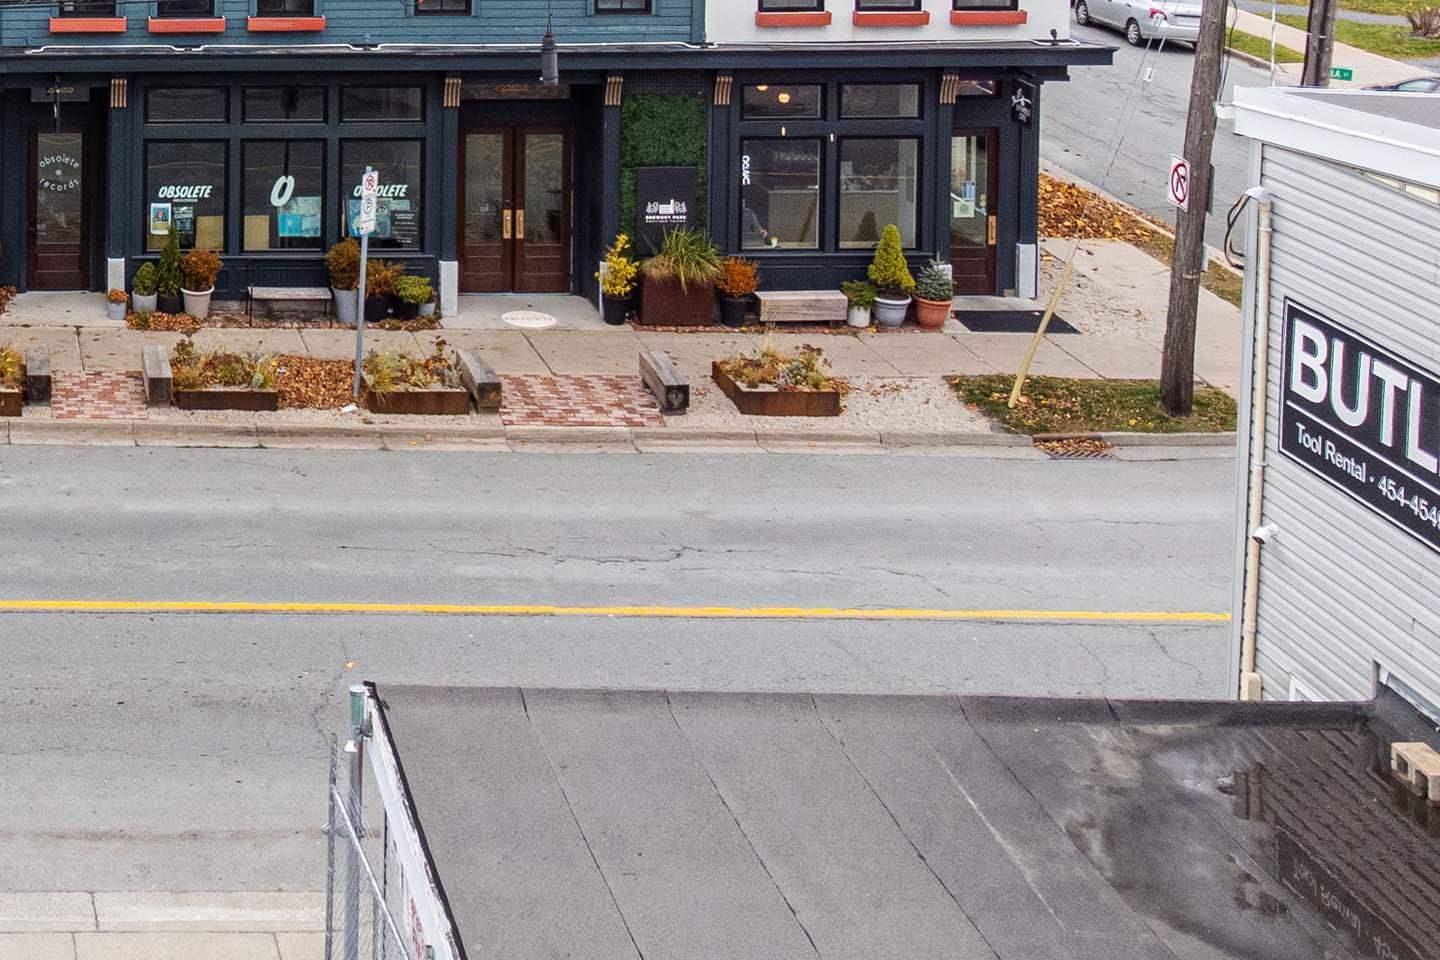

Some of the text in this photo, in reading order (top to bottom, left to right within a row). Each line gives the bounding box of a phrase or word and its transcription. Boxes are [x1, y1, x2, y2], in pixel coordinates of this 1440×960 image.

[39, 153, 80, 169] obsolete
[39, 178, 80, 191] records
[158, 185, 213, 198] OBSOLETE
[353, 184, 409, 198] OOLETE
[1291, 317, 1440, 476] BUTL
[1295, 422, 1440, 530] Tool Rental 454-454
